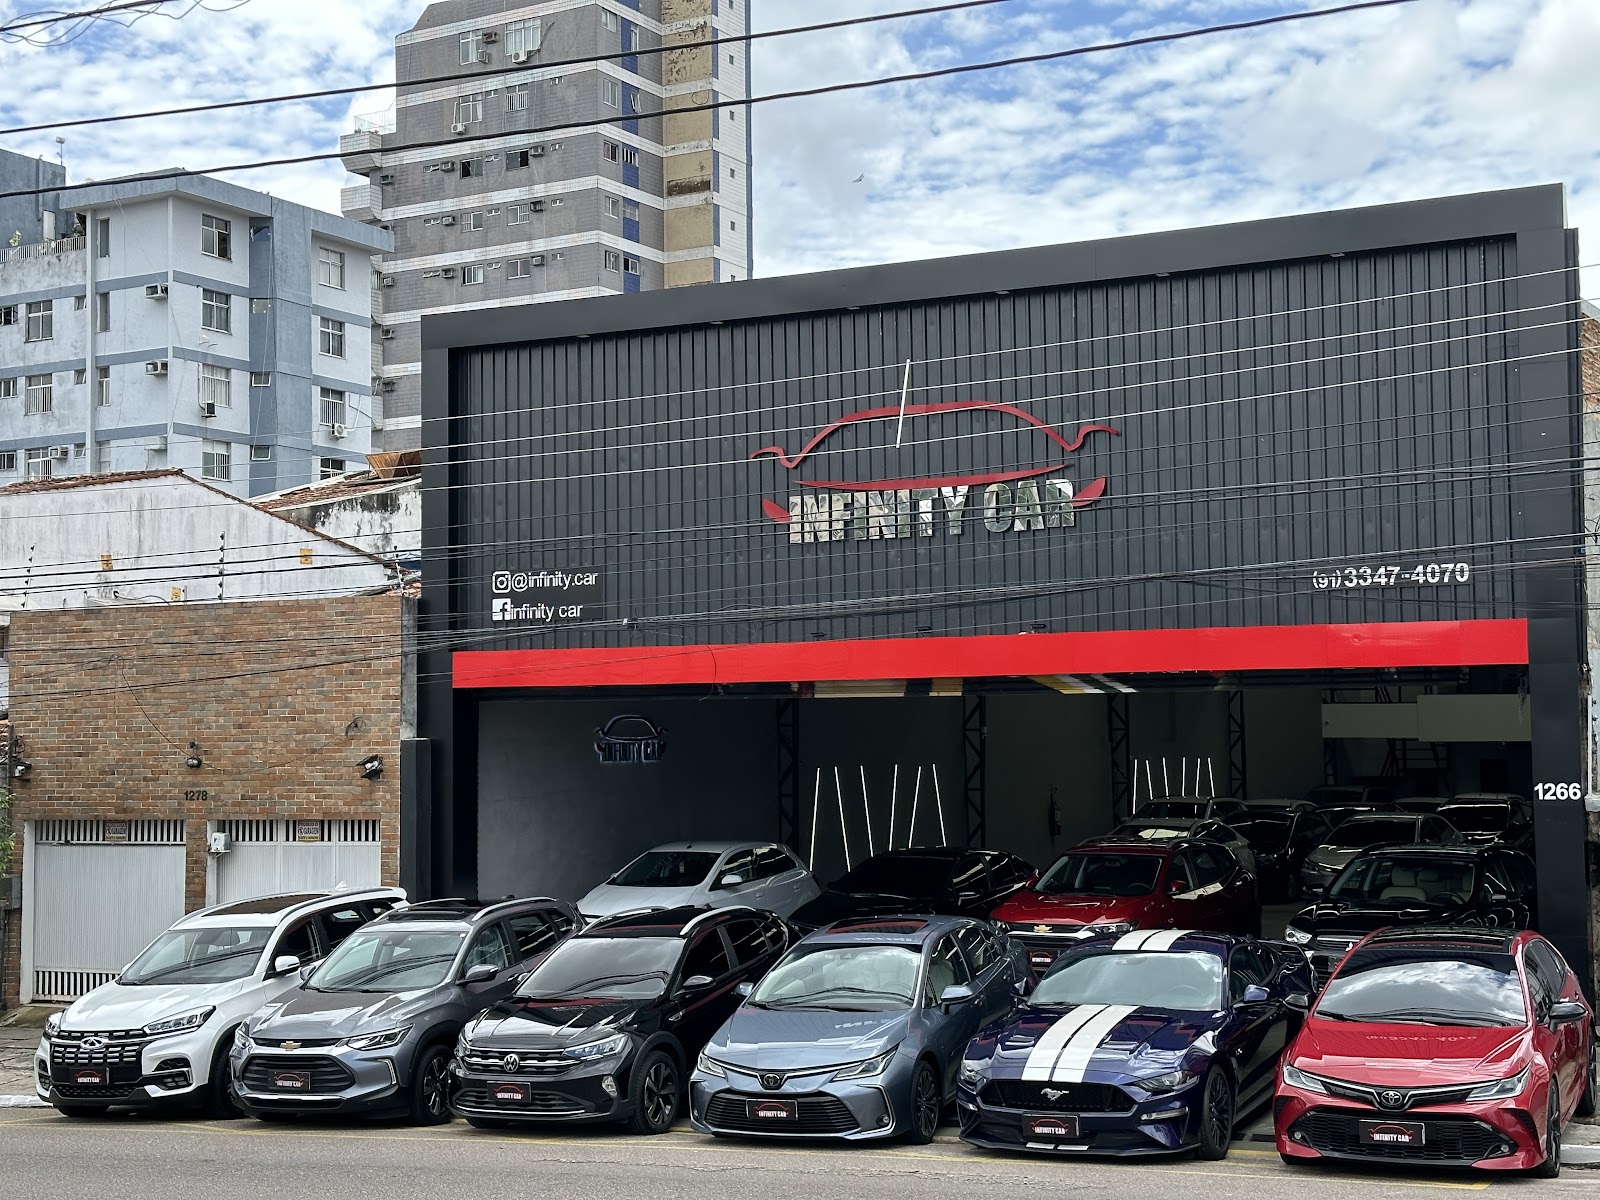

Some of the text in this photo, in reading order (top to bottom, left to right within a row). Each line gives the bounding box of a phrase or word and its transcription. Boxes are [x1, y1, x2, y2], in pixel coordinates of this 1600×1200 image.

[789, 479, 1076, 544] INFINITY CAR
[511, 571, 599, 592] @infinity.car
[558, 605, 583, 618] car
[184, 790, 208, 801] 1278
[1534, 782, 1582, 800] 1266
[1397, 1134, 1410, 1142] CAR
